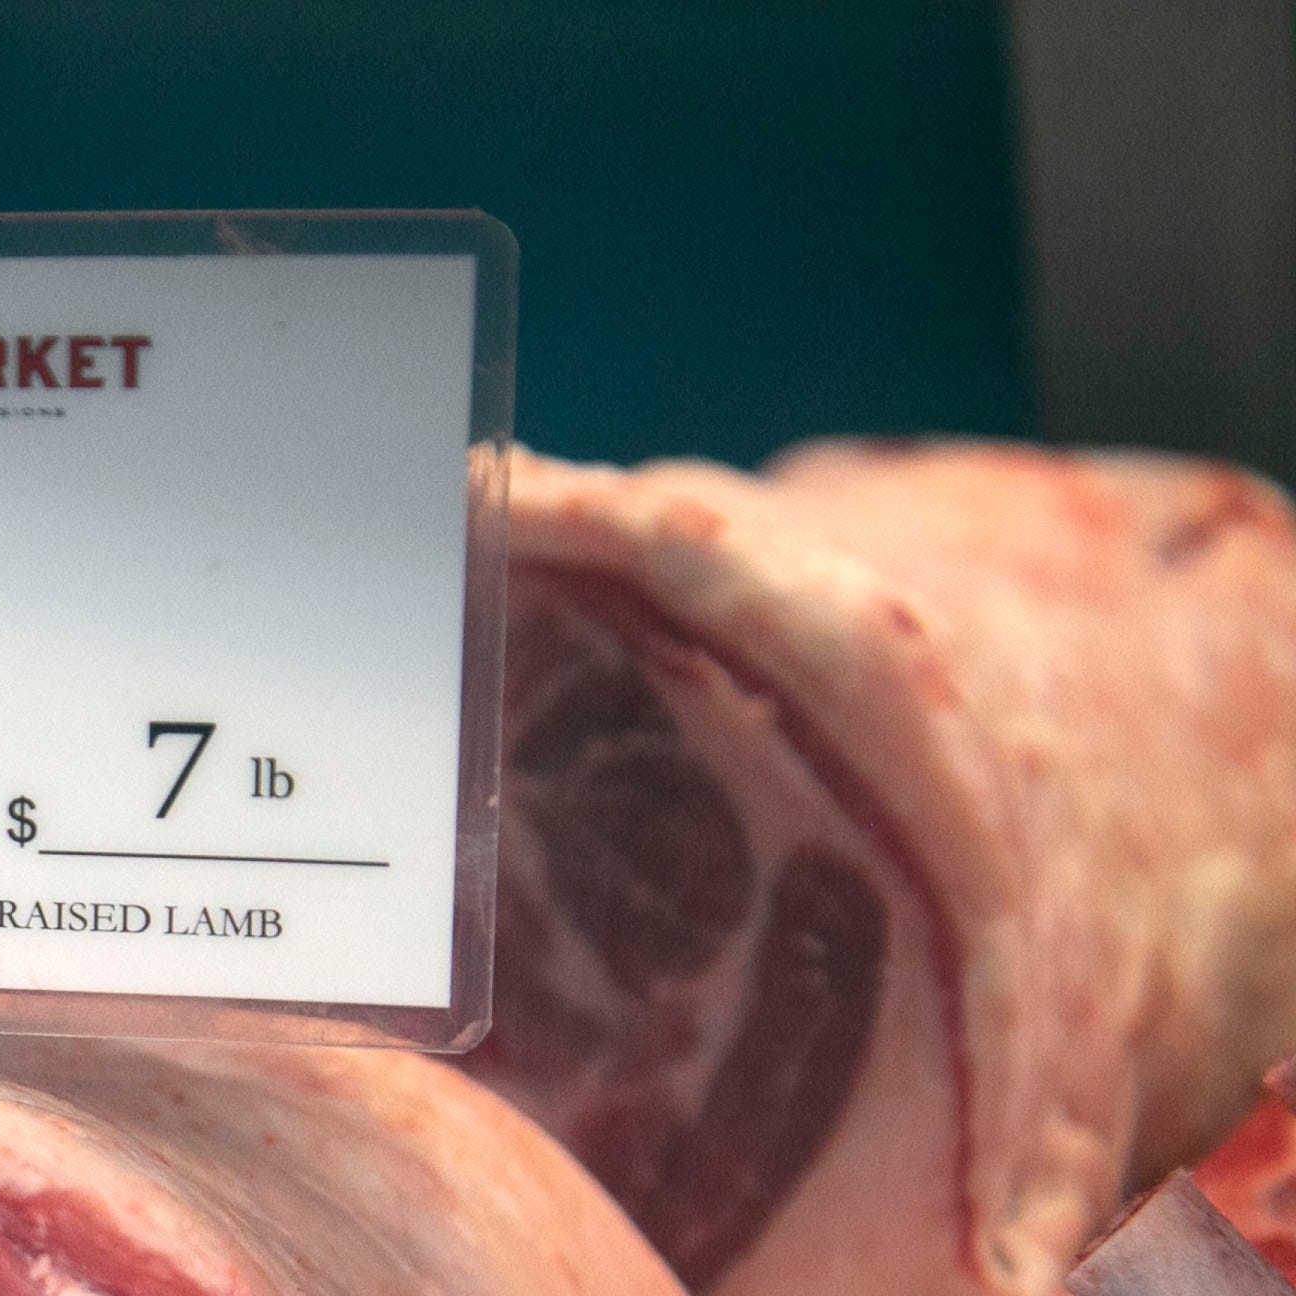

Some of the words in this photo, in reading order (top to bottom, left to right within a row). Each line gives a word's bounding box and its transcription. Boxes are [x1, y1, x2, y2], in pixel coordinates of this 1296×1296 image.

[6, 794, 39, 849] $
[148, 720, 217, 820] 7
[250, 756, 296, 799] lb
[163, 905, 284, 939] LAMB
